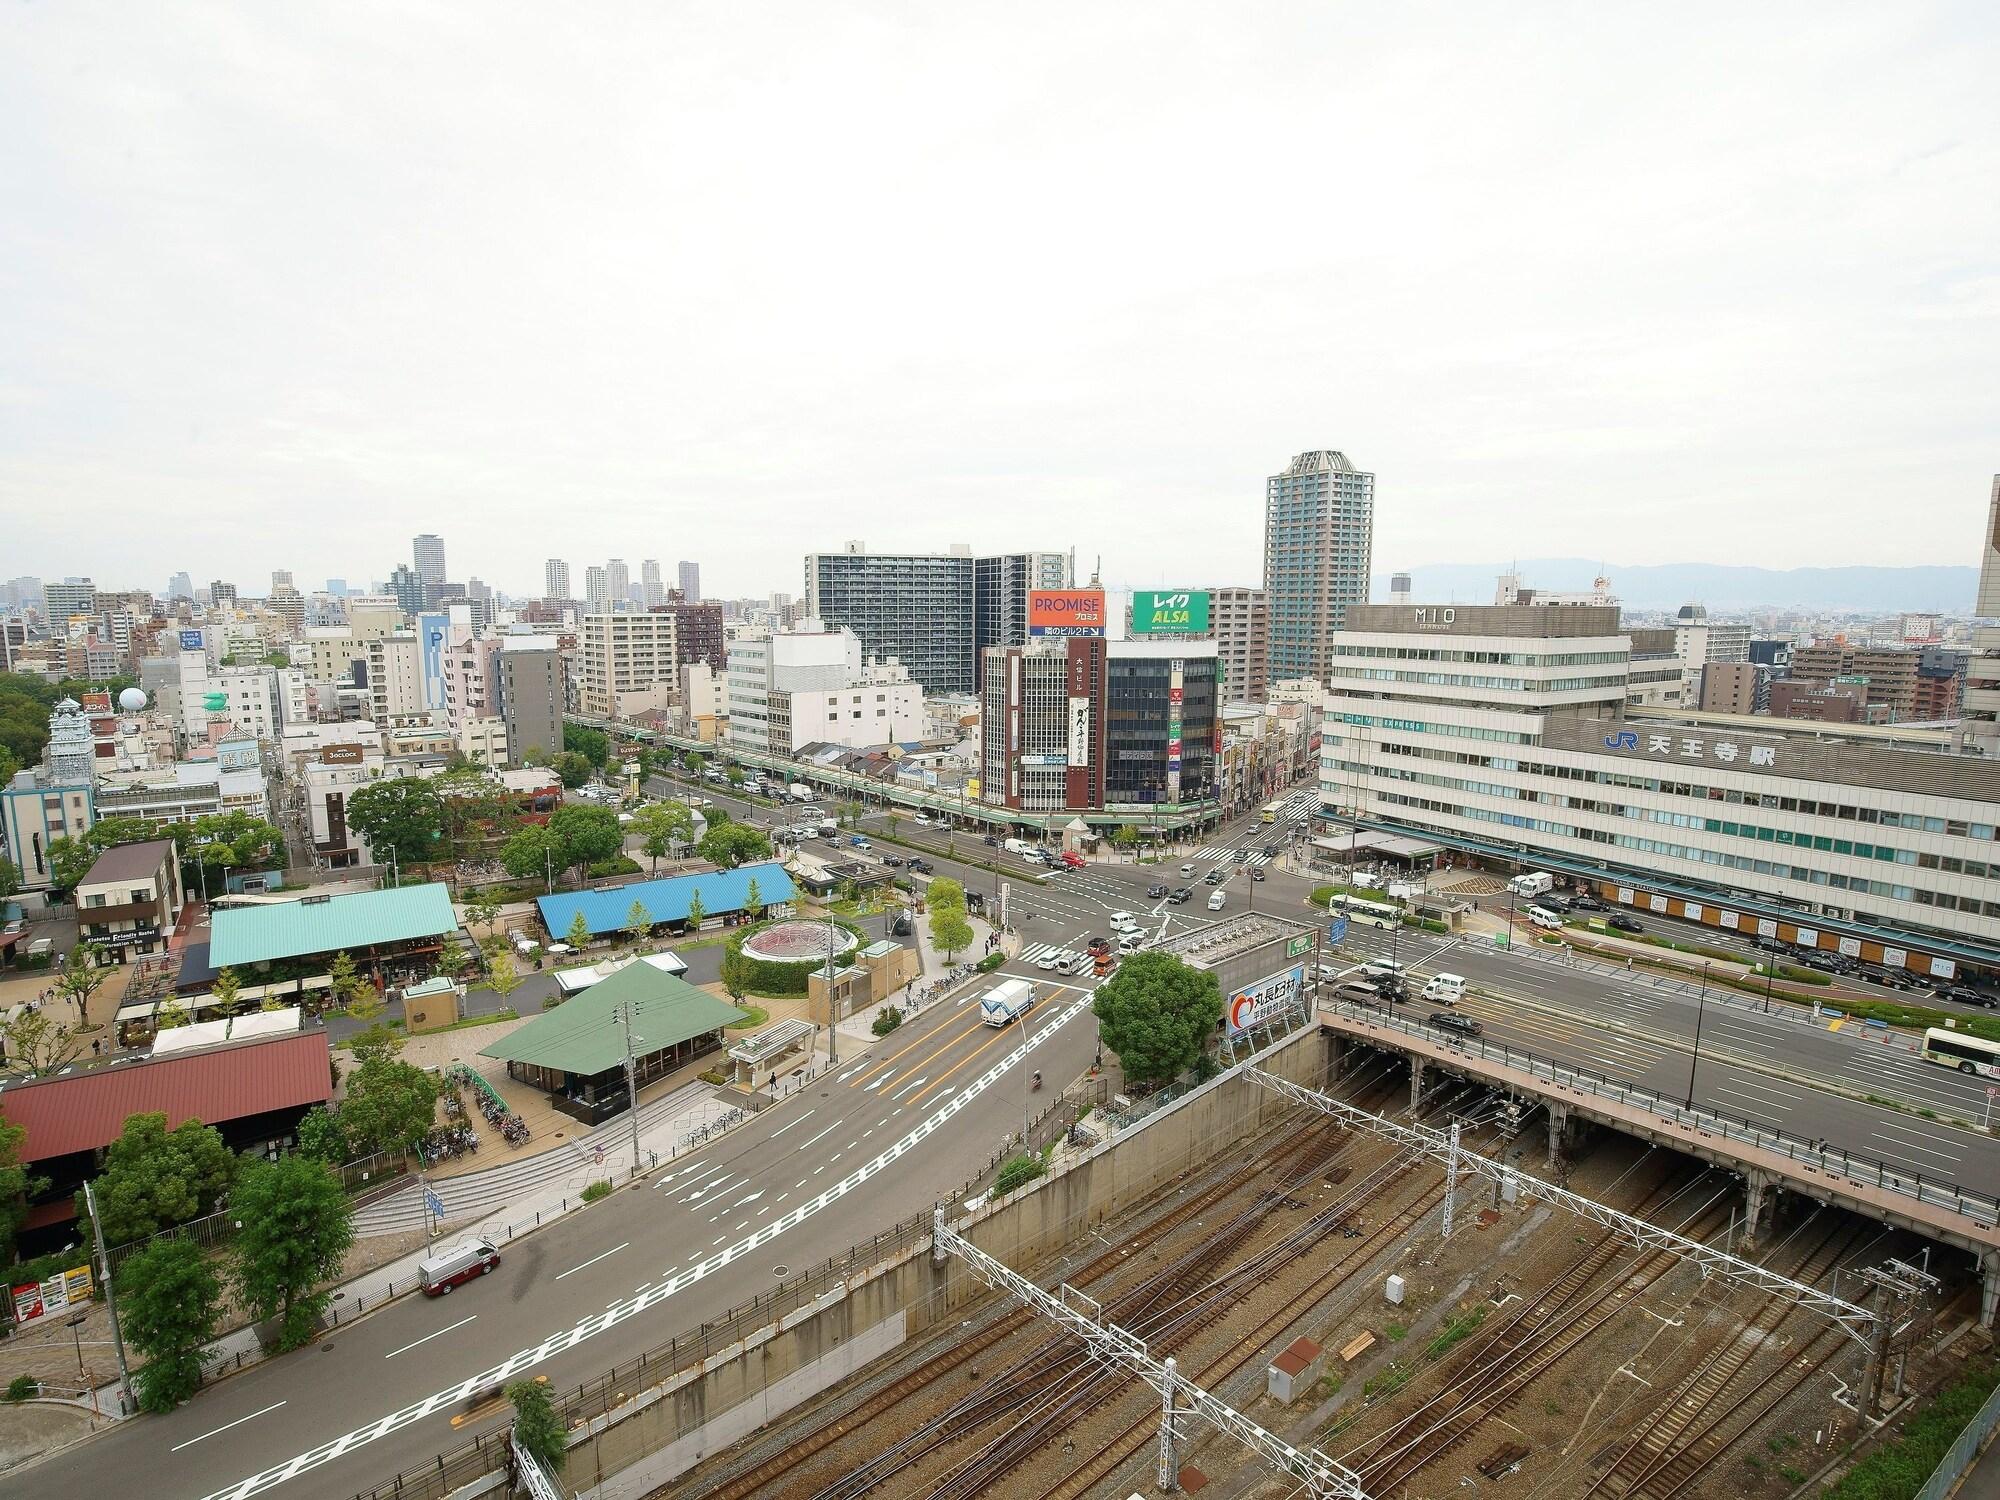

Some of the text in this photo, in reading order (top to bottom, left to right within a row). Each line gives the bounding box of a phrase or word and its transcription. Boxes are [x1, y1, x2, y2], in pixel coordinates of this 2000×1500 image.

[1035, 598, 1099, 612] PROMISE
[1153, 594, 1190, 609] レイク
[1075, 613, 1098, 621] プロミス
[1152, 610, 1189, 623] ALSA
[1415, 608, 1455, 623] MIO
[1604, 730, 1776, 767] JR 天王寺駅
